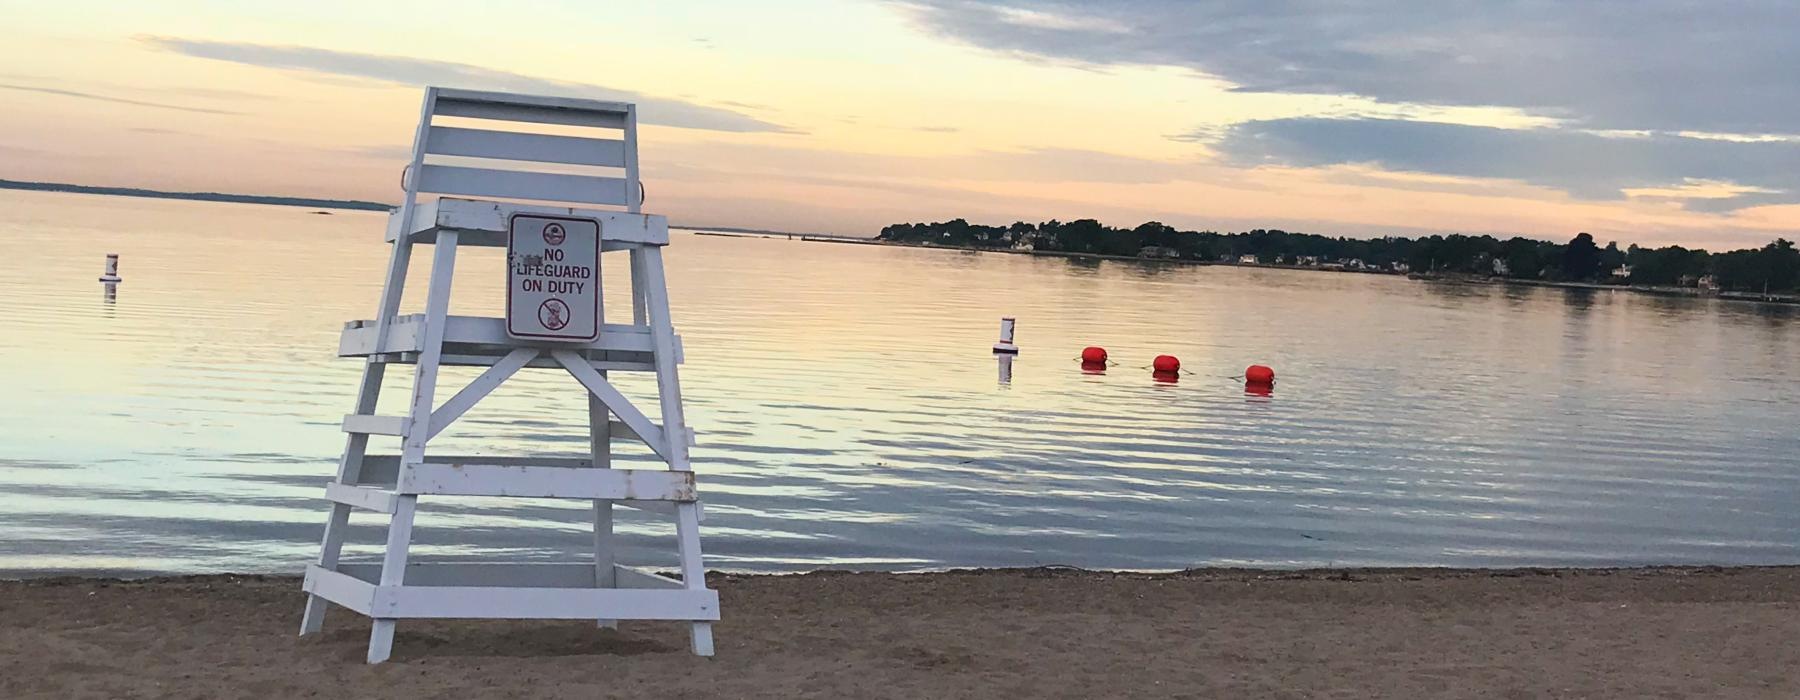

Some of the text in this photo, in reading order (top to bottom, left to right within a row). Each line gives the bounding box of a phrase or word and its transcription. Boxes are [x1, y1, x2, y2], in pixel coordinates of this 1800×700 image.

[544, 249, 564, 262] NO
[517, 263, 590, 279] LIFEGUARD
[522, 279, 584, 294] ON DUTY
